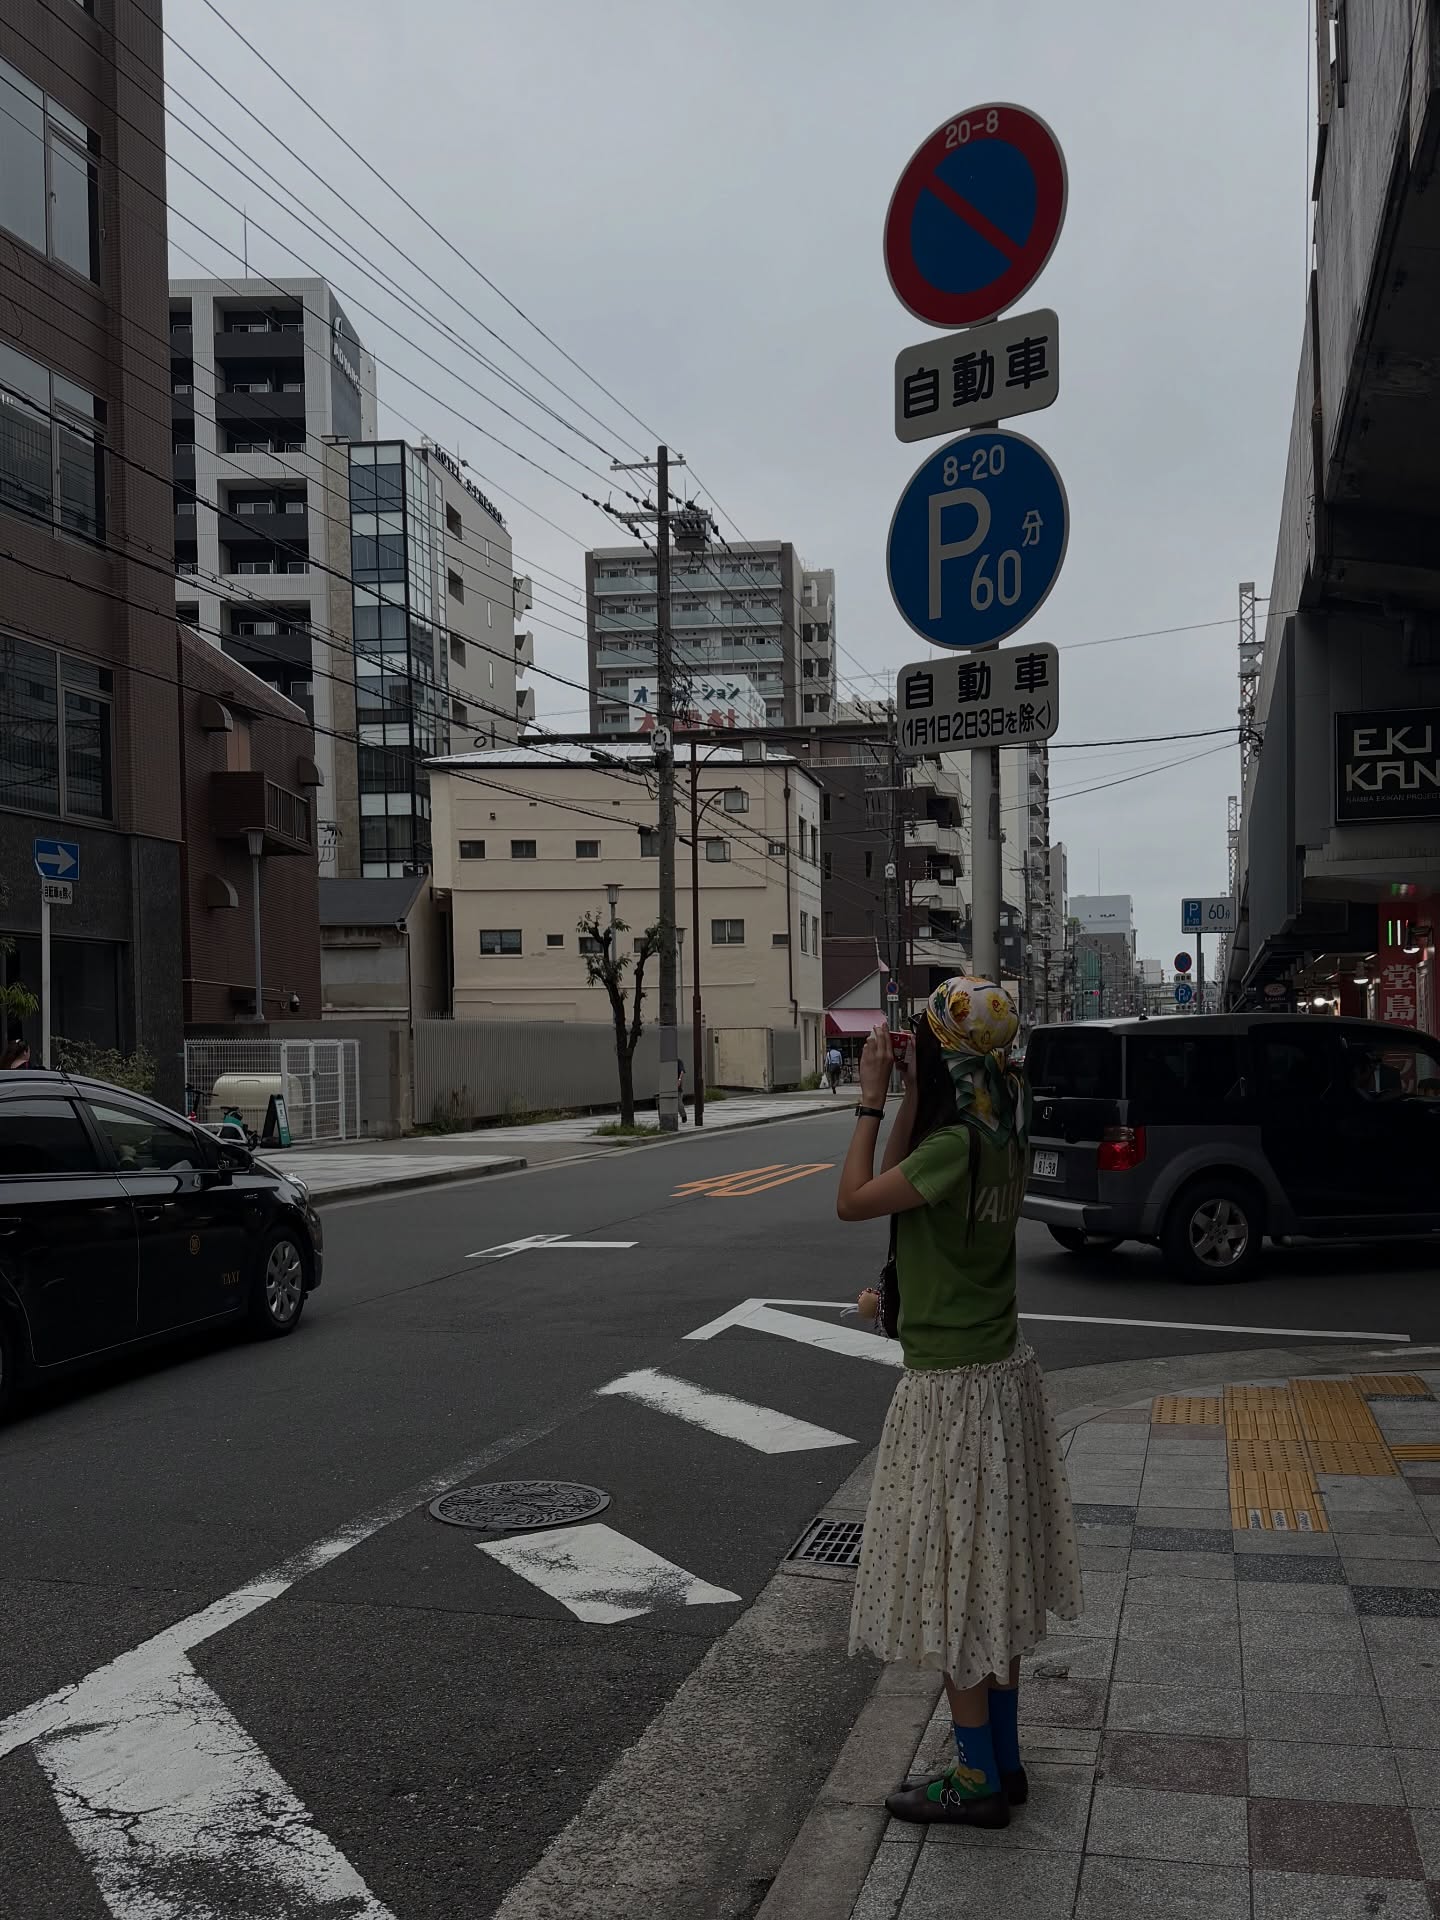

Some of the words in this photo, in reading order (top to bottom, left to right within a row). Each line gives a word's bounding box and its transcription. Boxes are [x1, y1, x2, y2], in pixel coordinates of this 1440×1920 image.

[944, 109, 1000, 149] 20-8
[903, 335, 1049, 419] 自動車
[943, 443, 1006, 487] 8-20
[928, 487, 992, 620] P
[1022, 509, 1045, 548] 分
[970, 549, 1022, 611] 60
[905, 652, 1049, 710] 自動車
[901, 699, 1051, 748] (1月1日2日3日を除く)
